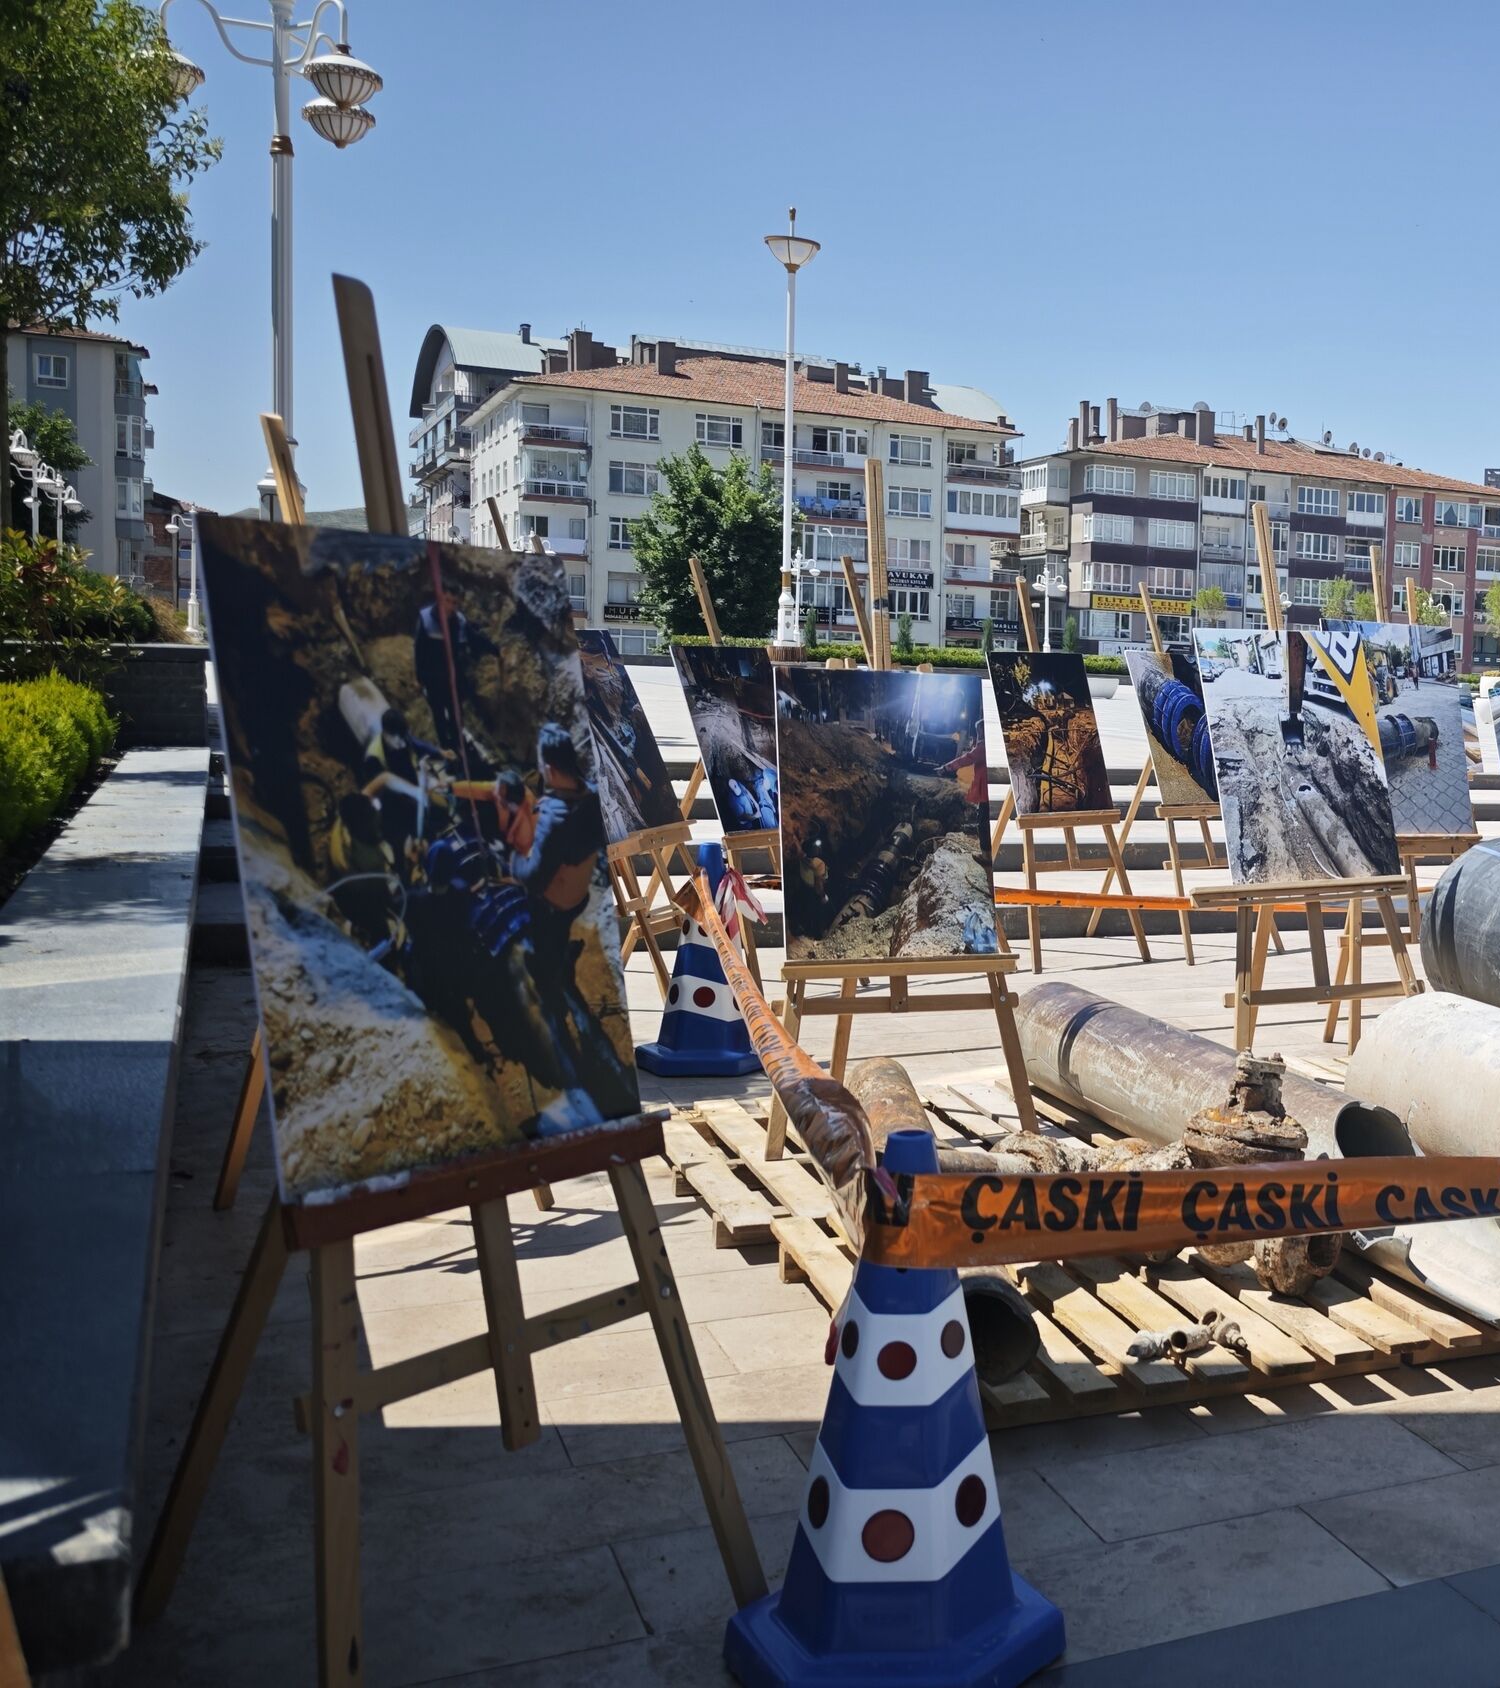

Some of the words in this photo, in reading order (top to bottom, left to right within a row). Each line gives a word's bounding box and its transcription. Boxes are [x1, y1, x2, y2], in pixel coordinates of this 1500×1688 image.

[888, 571, 929, 580] AVUKAT
[1129, 597, 1155, 605] ELT
[960, 1171, 1145, 1244] ÇASKİ
[1181, 1172, 1344, 1241] ÇASKİ
